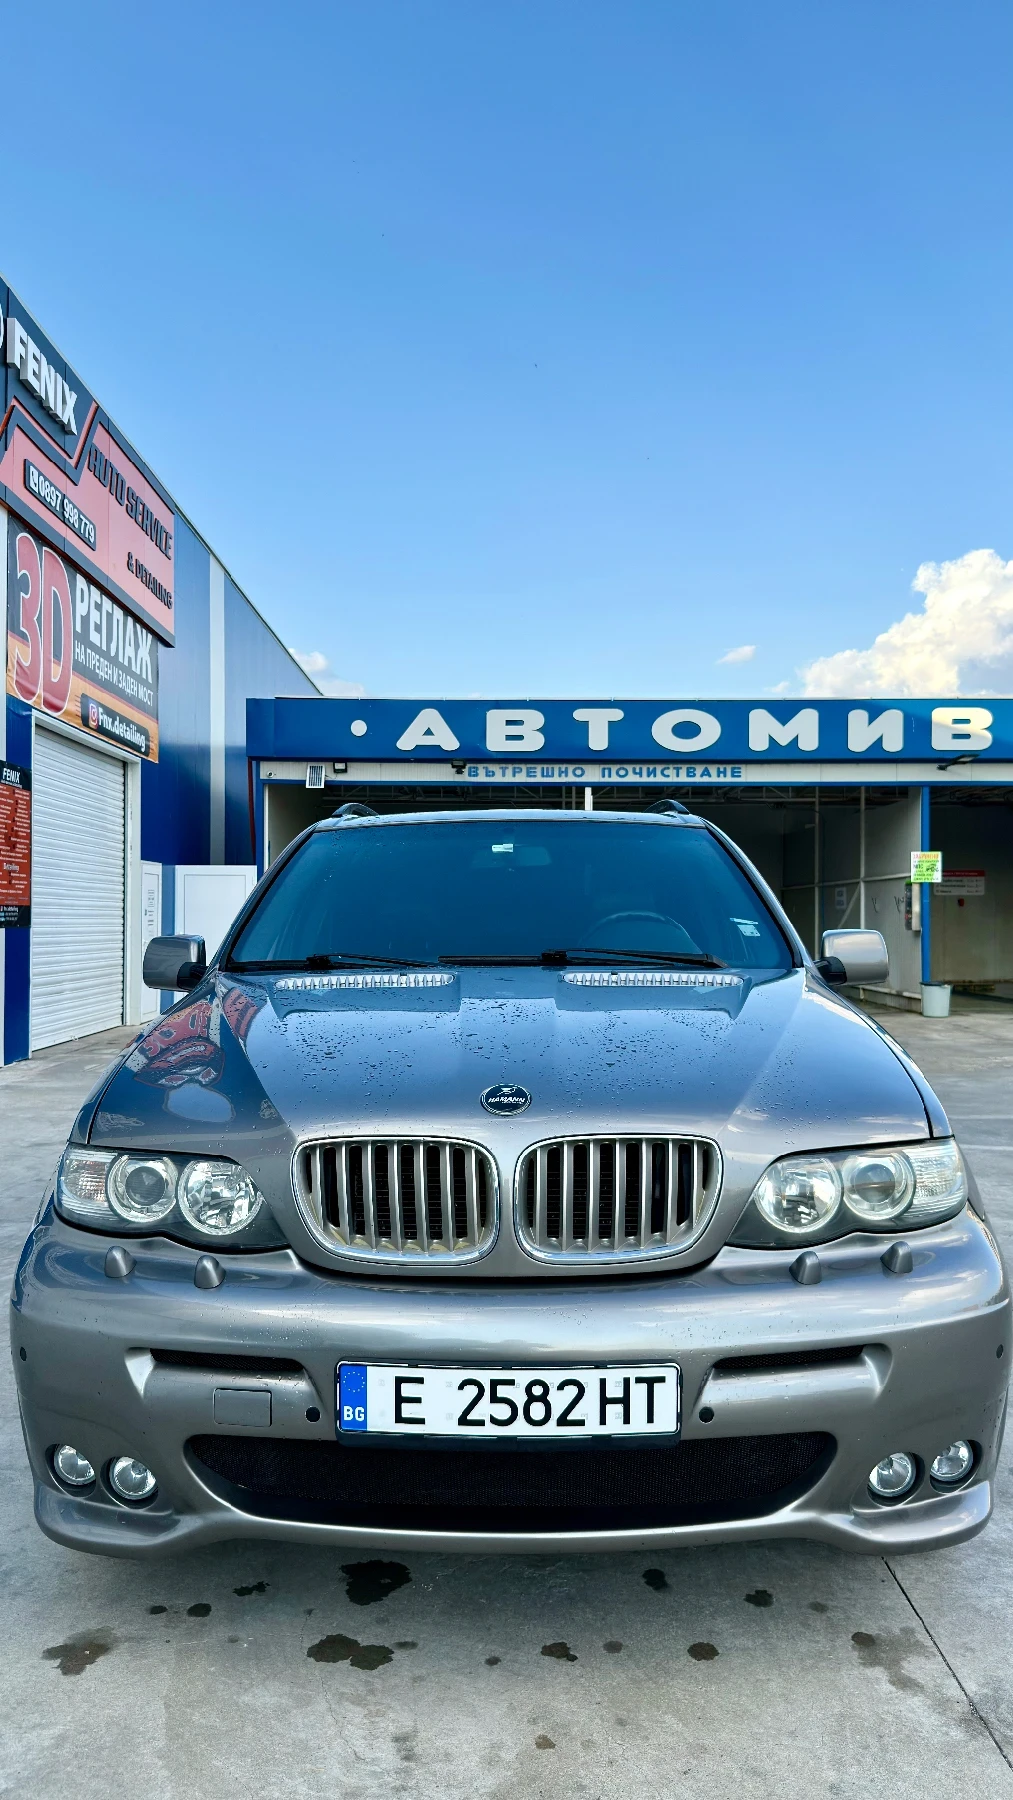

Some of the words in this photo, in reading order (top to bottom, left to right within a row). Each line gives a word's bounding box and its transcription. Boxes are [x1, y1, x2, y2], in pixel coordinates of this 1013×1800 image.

[7, 318, 78, 435] FENIX
[39, 475, 61, 511] 0897
[63, 498, 78, 529] 998
[80, 514, 95, 544] 779
[87, 443, 126, 507] AUTO
[126, 486, 173, 560] SERVICE
[127, 552, 134, 574] &
[135, 558, 173, 609] DETAILING
[14, 532, 73, 716] 3D
[75, 573, 153, 684] РЕГЛАЖ
[75, 640, 85, 665] НА
[86, 647, 112, 681] ПРЕДЕН
[113, 666, 118, 686] И
[119, 669, 138, 697] ЗАДЕН
[138, 683, 153, 707] МОСТ
[98, 706, 146, 752] Fnx.detailing
[467, 766, 586, 779] ВЪТРЕШНО
[601, 766, 742, 779] ПОЧИСТВАНЕ
[343, 1406, 365, 1421] BG
[394, 1376, 426, 1425] E
[457, 1378, 586, 1427] 2582
[599, 1376, 666, 1426] HT
